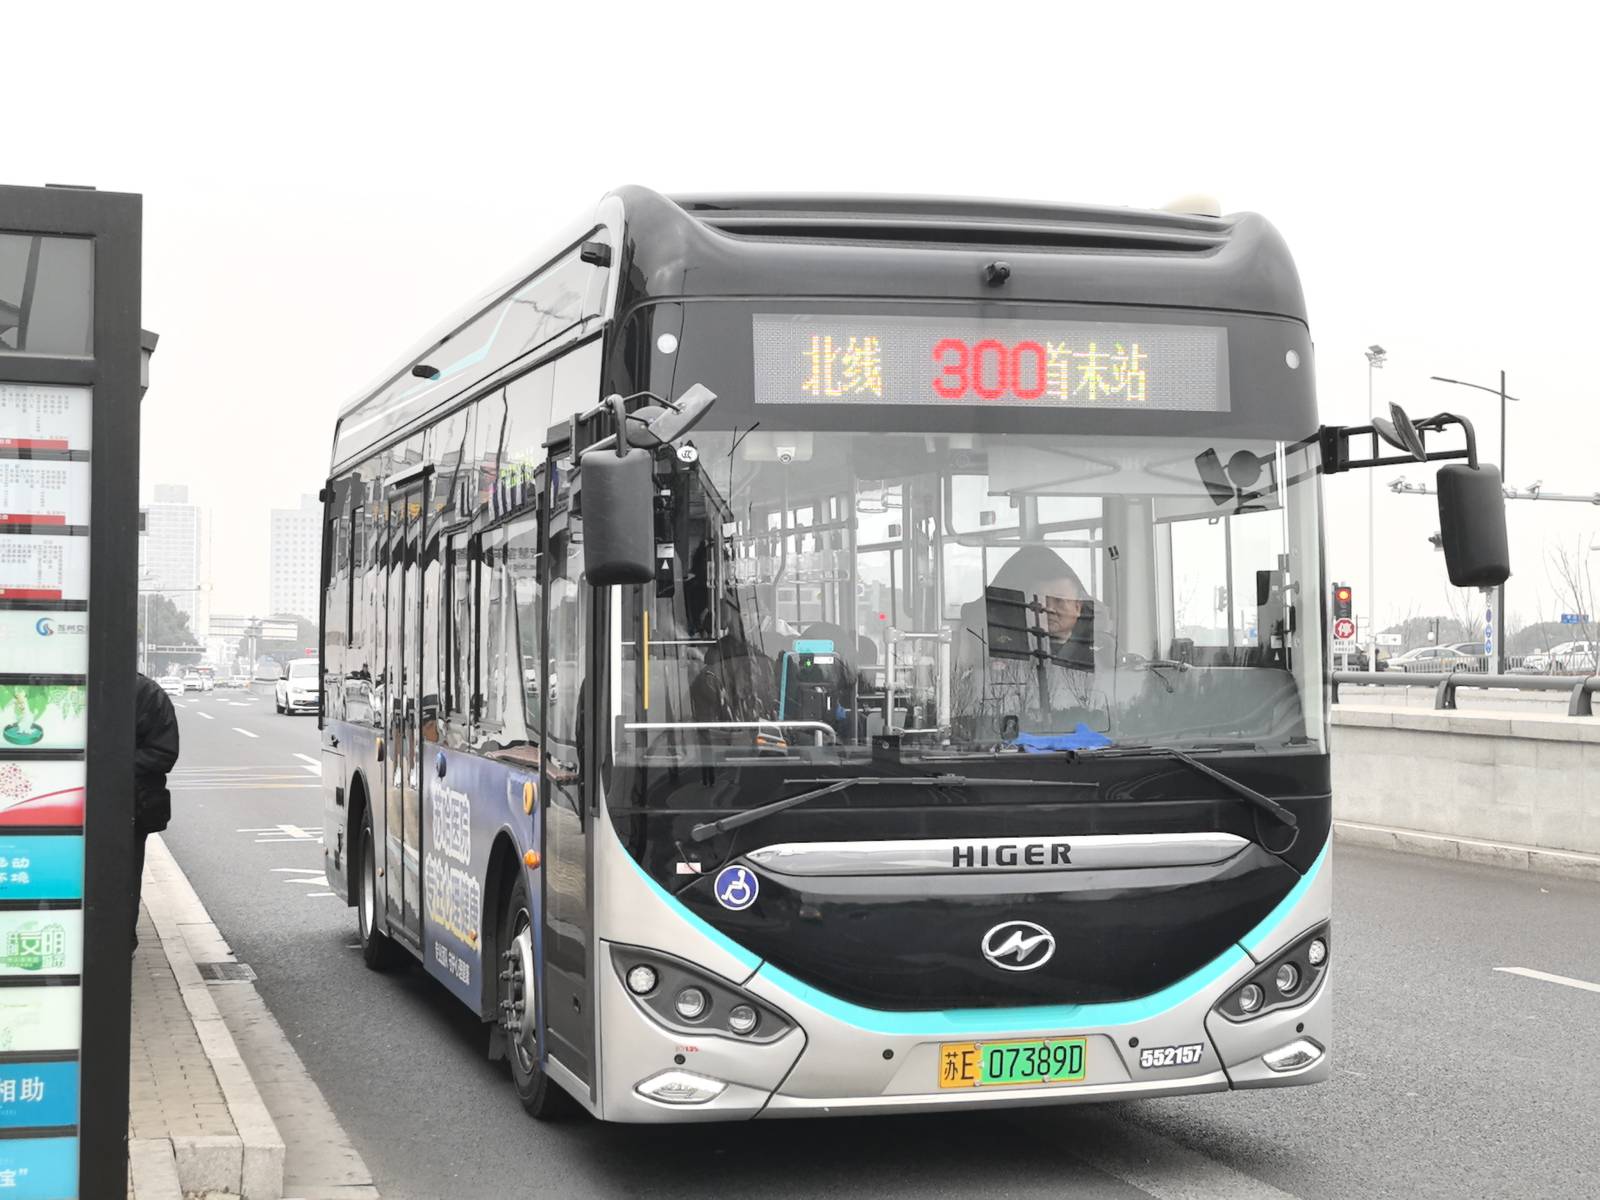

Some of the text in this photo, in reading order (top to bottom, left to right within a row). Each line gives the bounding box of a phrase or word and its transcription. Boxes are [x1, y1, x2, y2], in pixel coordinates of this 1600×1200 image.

[802, 336, 882, 396] 北线
[932, 338, 1047, 399] 300
[1045, 341, 1148, 401] 首末站
[952, 843, 1072, 868] HIGER
[944, 1044, 1083, 1081] 苏E 07389D
[1140, 1044, 1203, 1068] 552157
[0, 1076, 45, 1102] 相助
